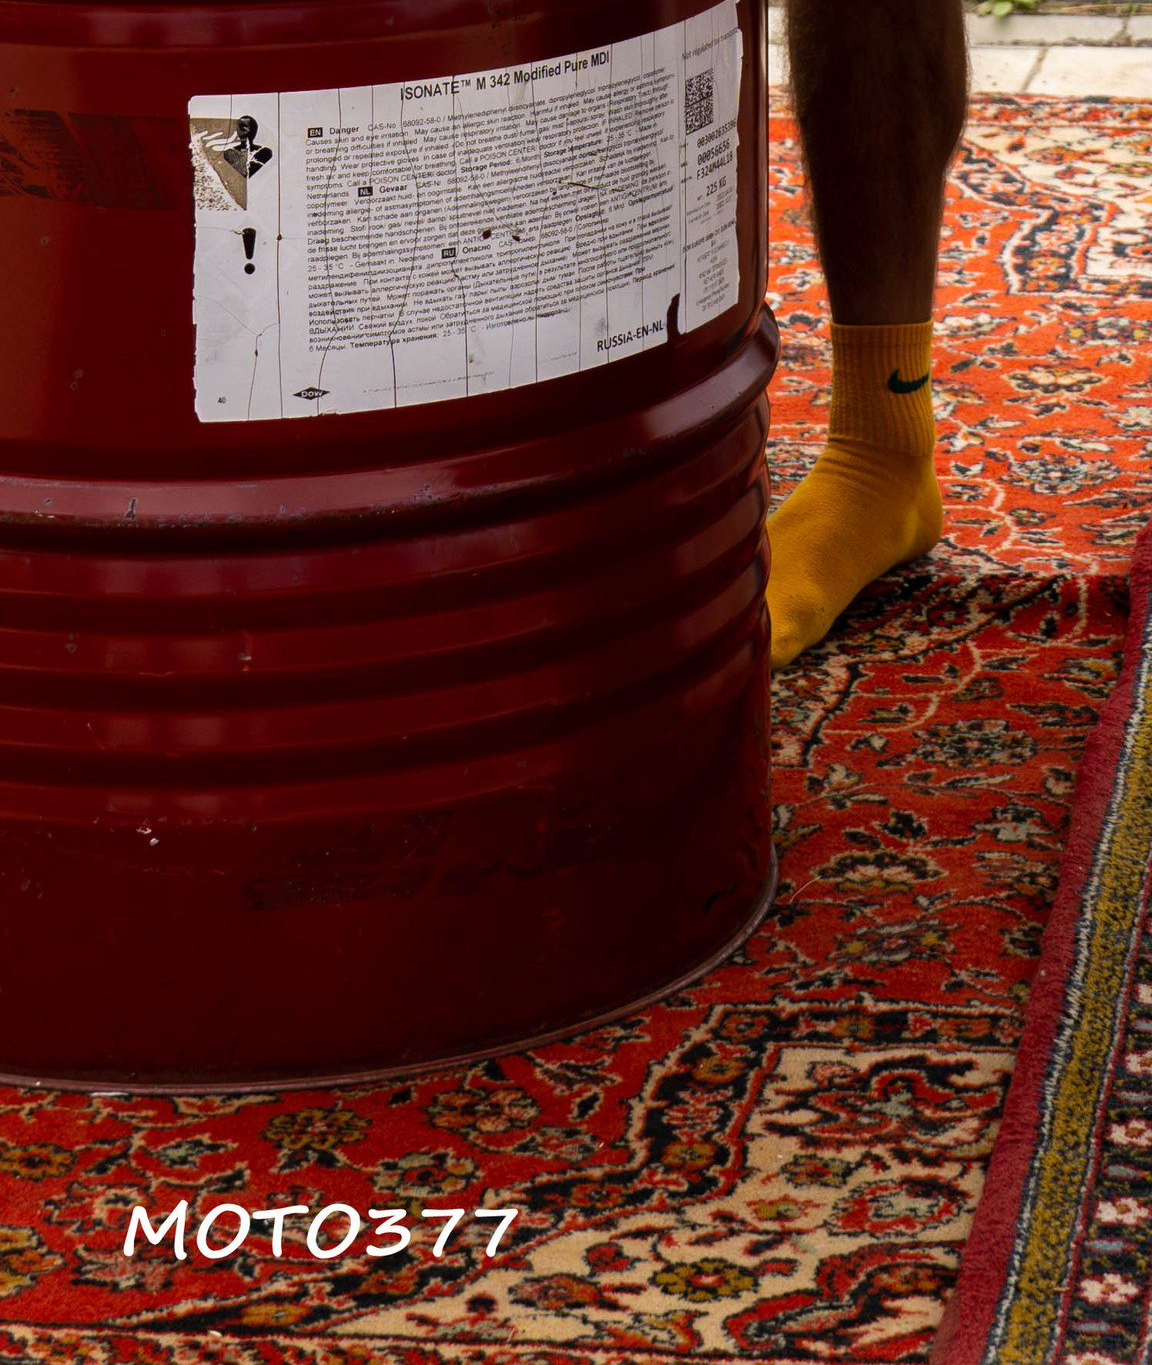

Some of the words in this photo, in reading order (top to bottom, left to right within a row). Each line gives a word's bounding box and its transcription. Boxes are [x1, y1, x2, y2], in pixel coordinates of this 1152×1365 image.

[476, 77, 487, 91] M
[490, 73, 510, 88] 342
[513, 62, 561, 85] Modified
[564, 58, 588, 75] Pure
[591, 51, 610, 67] MDI
[305, 137, 331, 146] Causes
[350, 134, 364, 142] and
[414, 127, 428, 136] May
[430, 124, 450, 133] cause
[310, 128, 322, 136] EN
[329, 124, 359, 136] Danger
[336, 171, 350, 179] and
[352, 169, 369, 179] keep
[360, 187, 371, 195] NL
[379, 183, 407, 194] Gevaar
[706, 181, 718, 196] 225
[719, 176, 727, 189] KG
[443, 249, 454, 257] RU
[462, 243, 491, 255] Опасно
[301, 390, 322, 398] DOW
